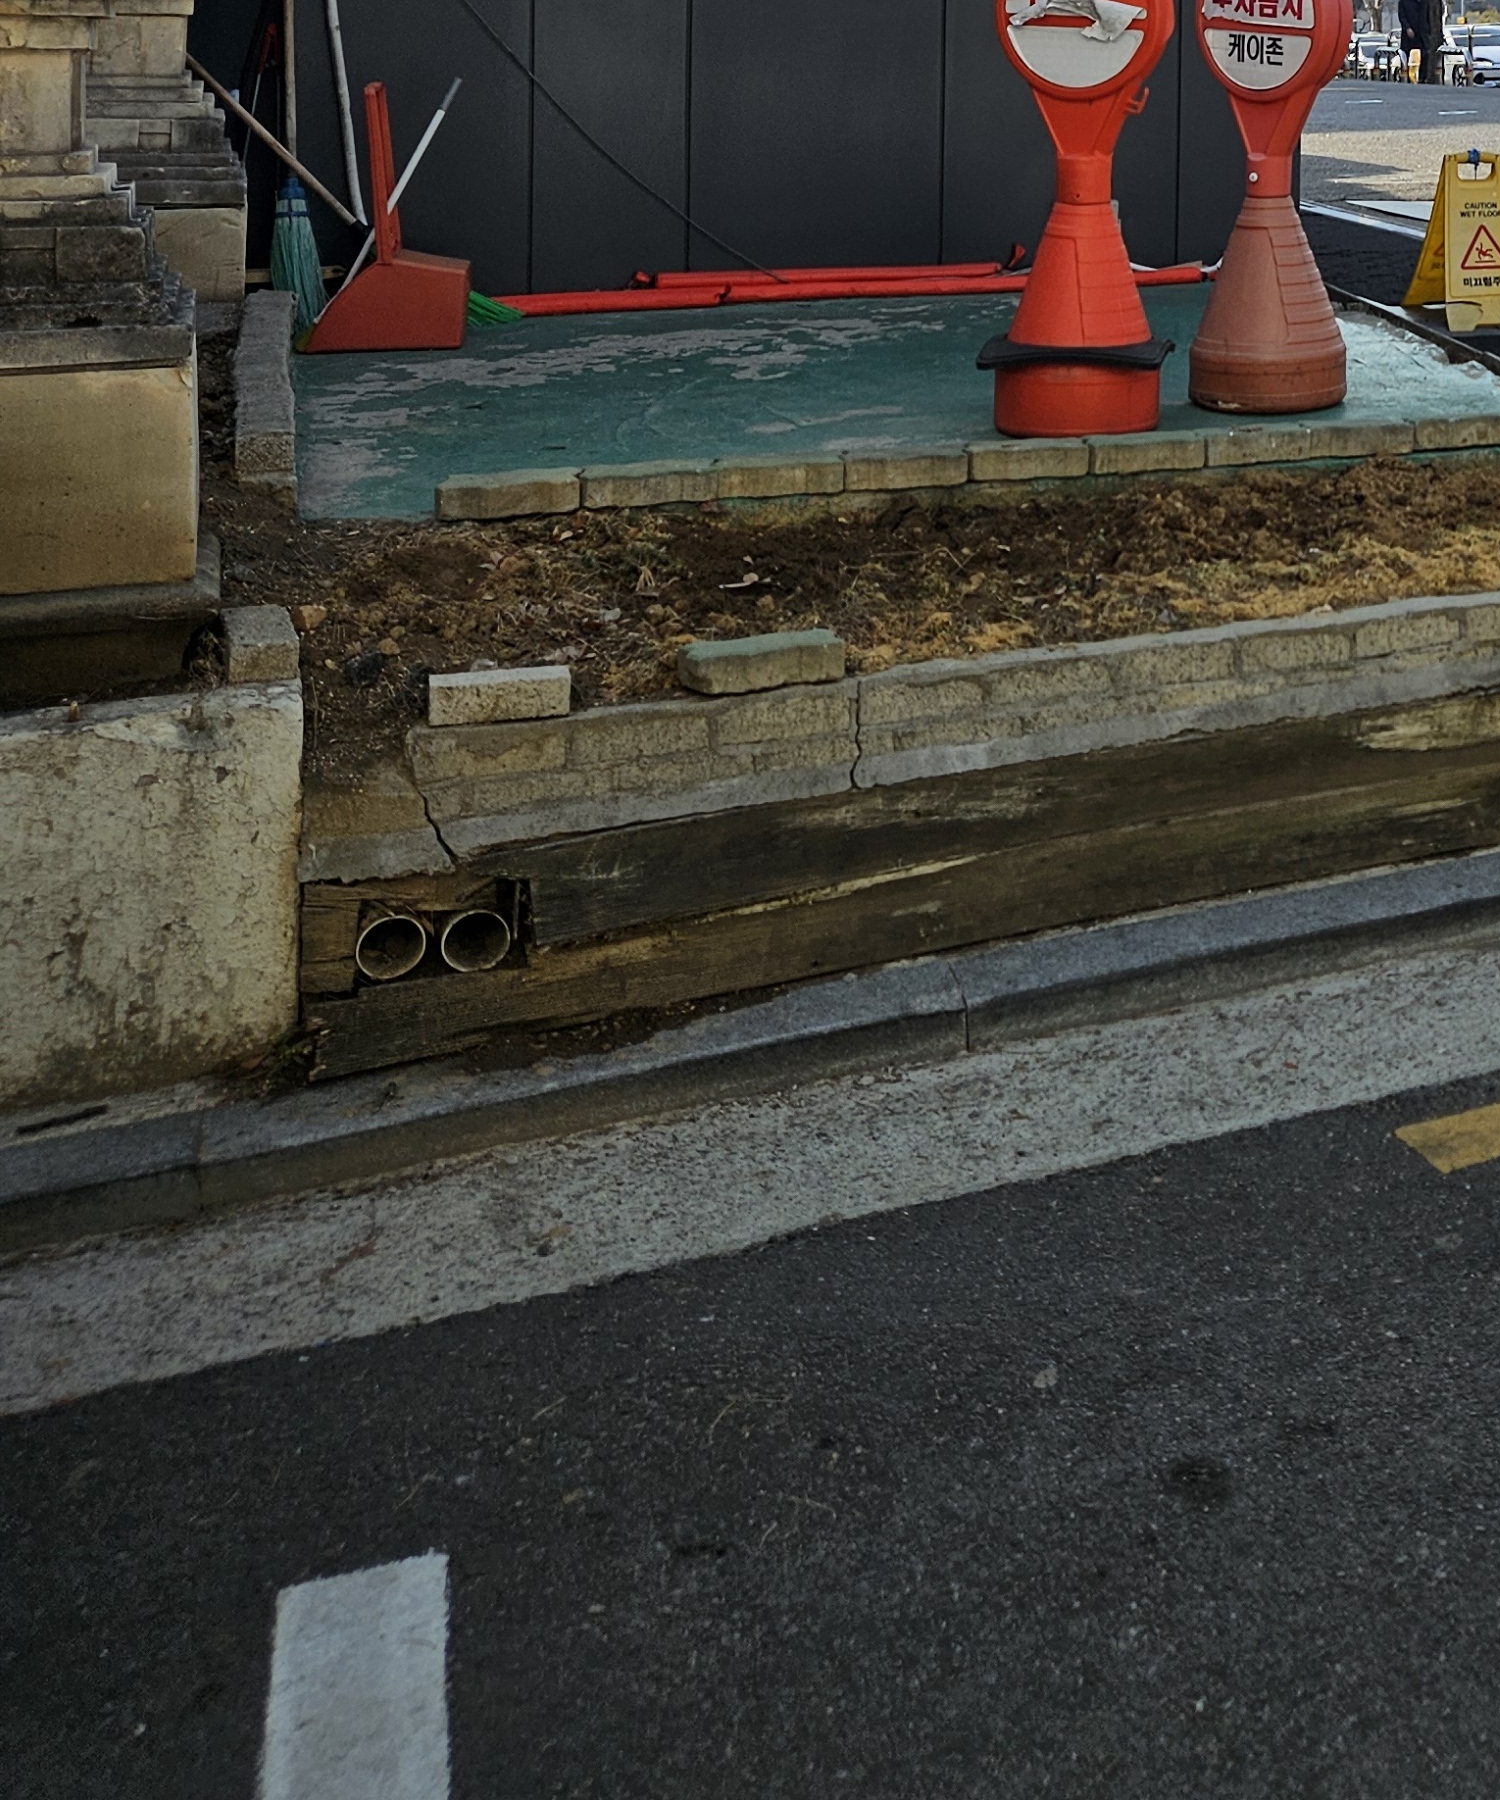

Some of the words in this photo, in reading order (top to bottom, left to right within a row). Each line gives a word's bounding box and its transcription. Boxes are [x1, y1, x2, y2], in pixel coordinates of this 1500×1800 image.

[1228, 33, 1284, 66] 케이존
[1464, 201, 1498, 210] CAUTION
[1460, 210, 1476, 218] WET
